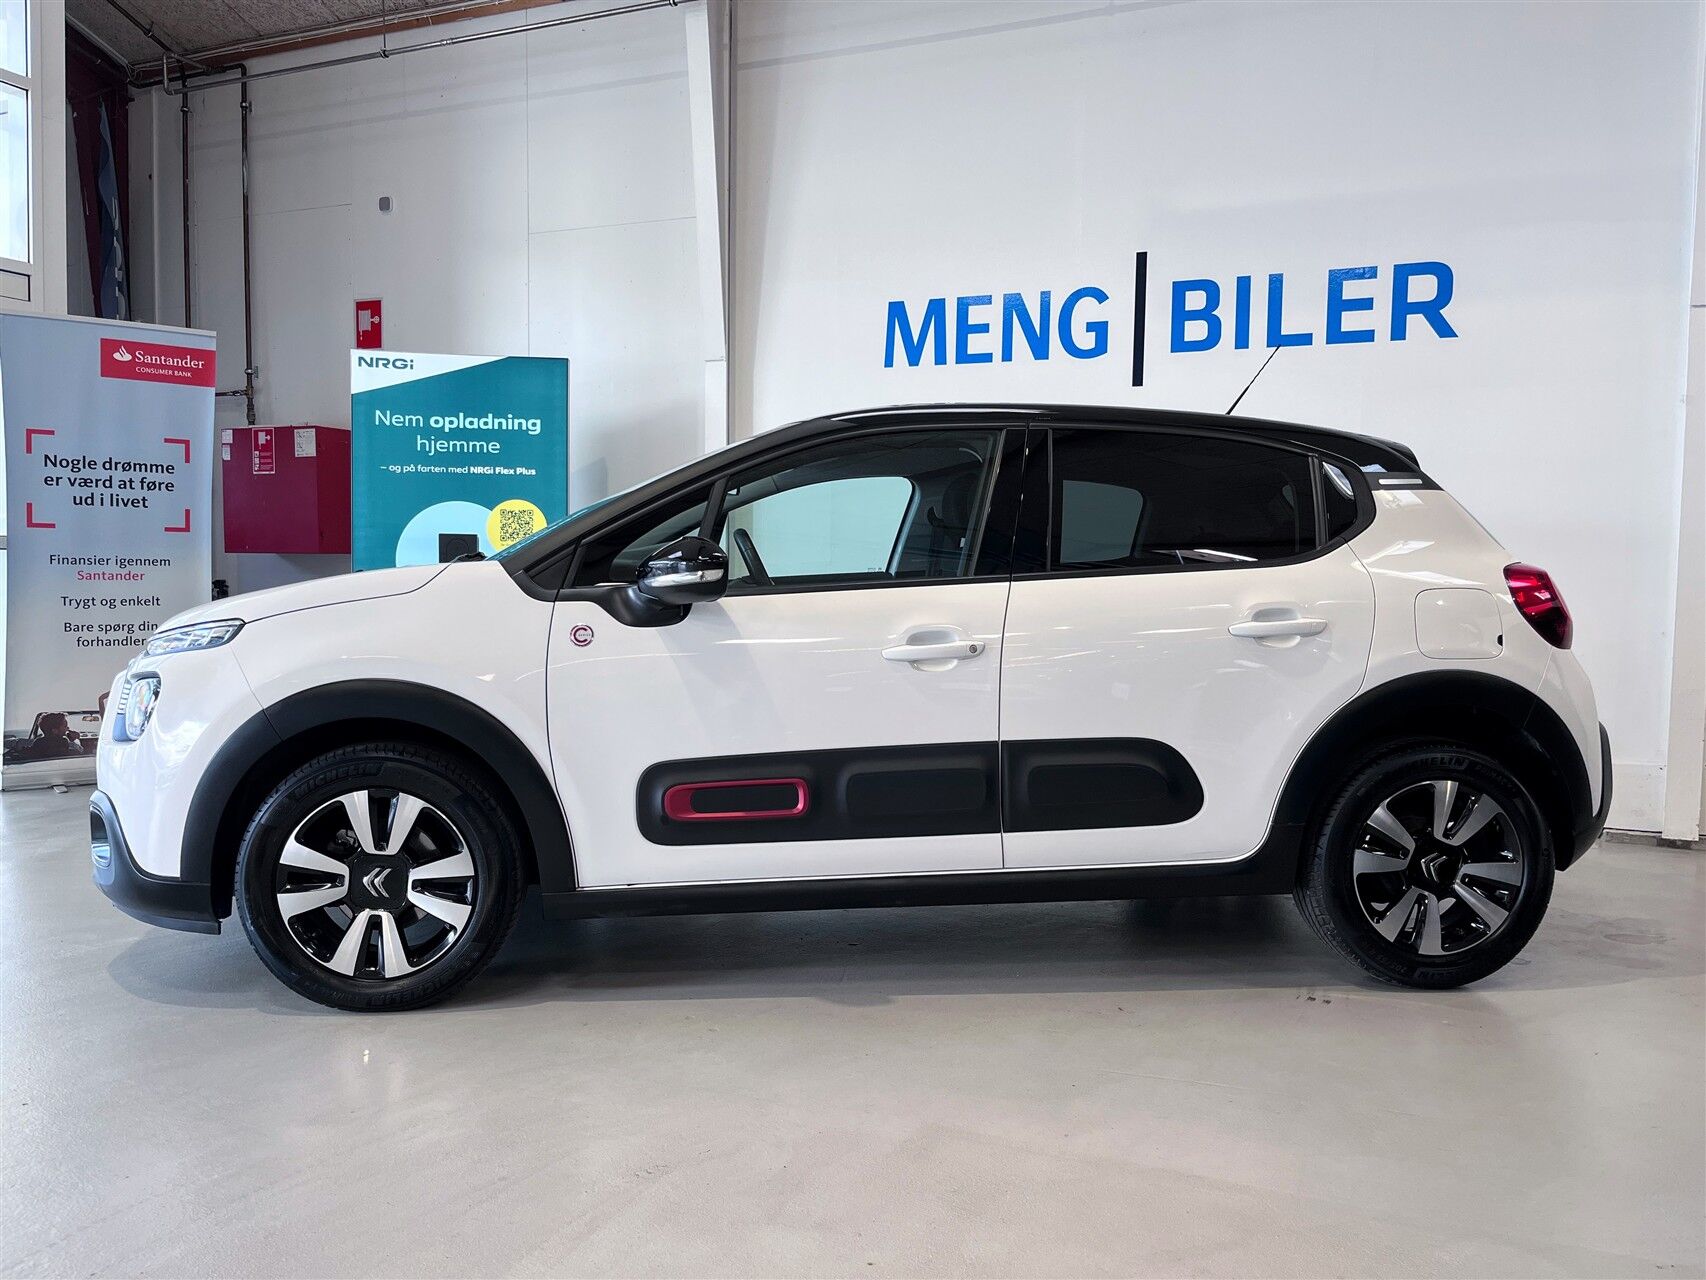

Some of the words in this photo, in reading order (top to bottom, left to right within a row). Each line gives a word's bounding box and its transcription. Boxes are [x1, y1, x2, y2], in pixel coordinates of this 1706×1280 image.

[883, 286, 1110, 369] MENG
[1170, 261, 1459, 354] BILER
[135, 350, 204, 369] Santander
[358, 356, 414, 370] NRGi
[135, 366, 173, 376] CONSUMER
[174, 370, 192, 378] BANK
[375, 410, 423, 427] Nem
[429, 413, 541, 434] opladning
[417, 435, 500, 456] hjemme
[43, 454, 97, 472] Nogle
[102, 457, 175, 474] drømme
[389, 465, 401, 473] og
[403, 464, 416, 474] på
[417, 465, 446, 474] farten
[448, 466, 468, 474] med
[470, 467, 494, 475] NRGi
[495, 467, 514, 475] Flex
[516, 467, 536, 475] Plus
[43, 475, 63, 487] er
[67, 475, 113, 490] værd
[118, 478, 135, 490] at
[140, 477, 175, 492] føre
[73, 493, 94, 506] ud
[100, 493, 104, 507] i
[109, 494, 148, 508] livet
[49, 554, 111, 566] Finansier
[115, 555, 171, 570] igennem
[77, 570, 145, 581] Santander
[61, 596, 96, 610] Trygt
[100, 598, 116, 610] og
[120, 596, 160, 607] enkelt
[64, 622, 94, 633] Bare
[98, 622, 135, 636] spørg
[138, 621, 158, 632] din
[76, 636, 146, 648] forhandler
